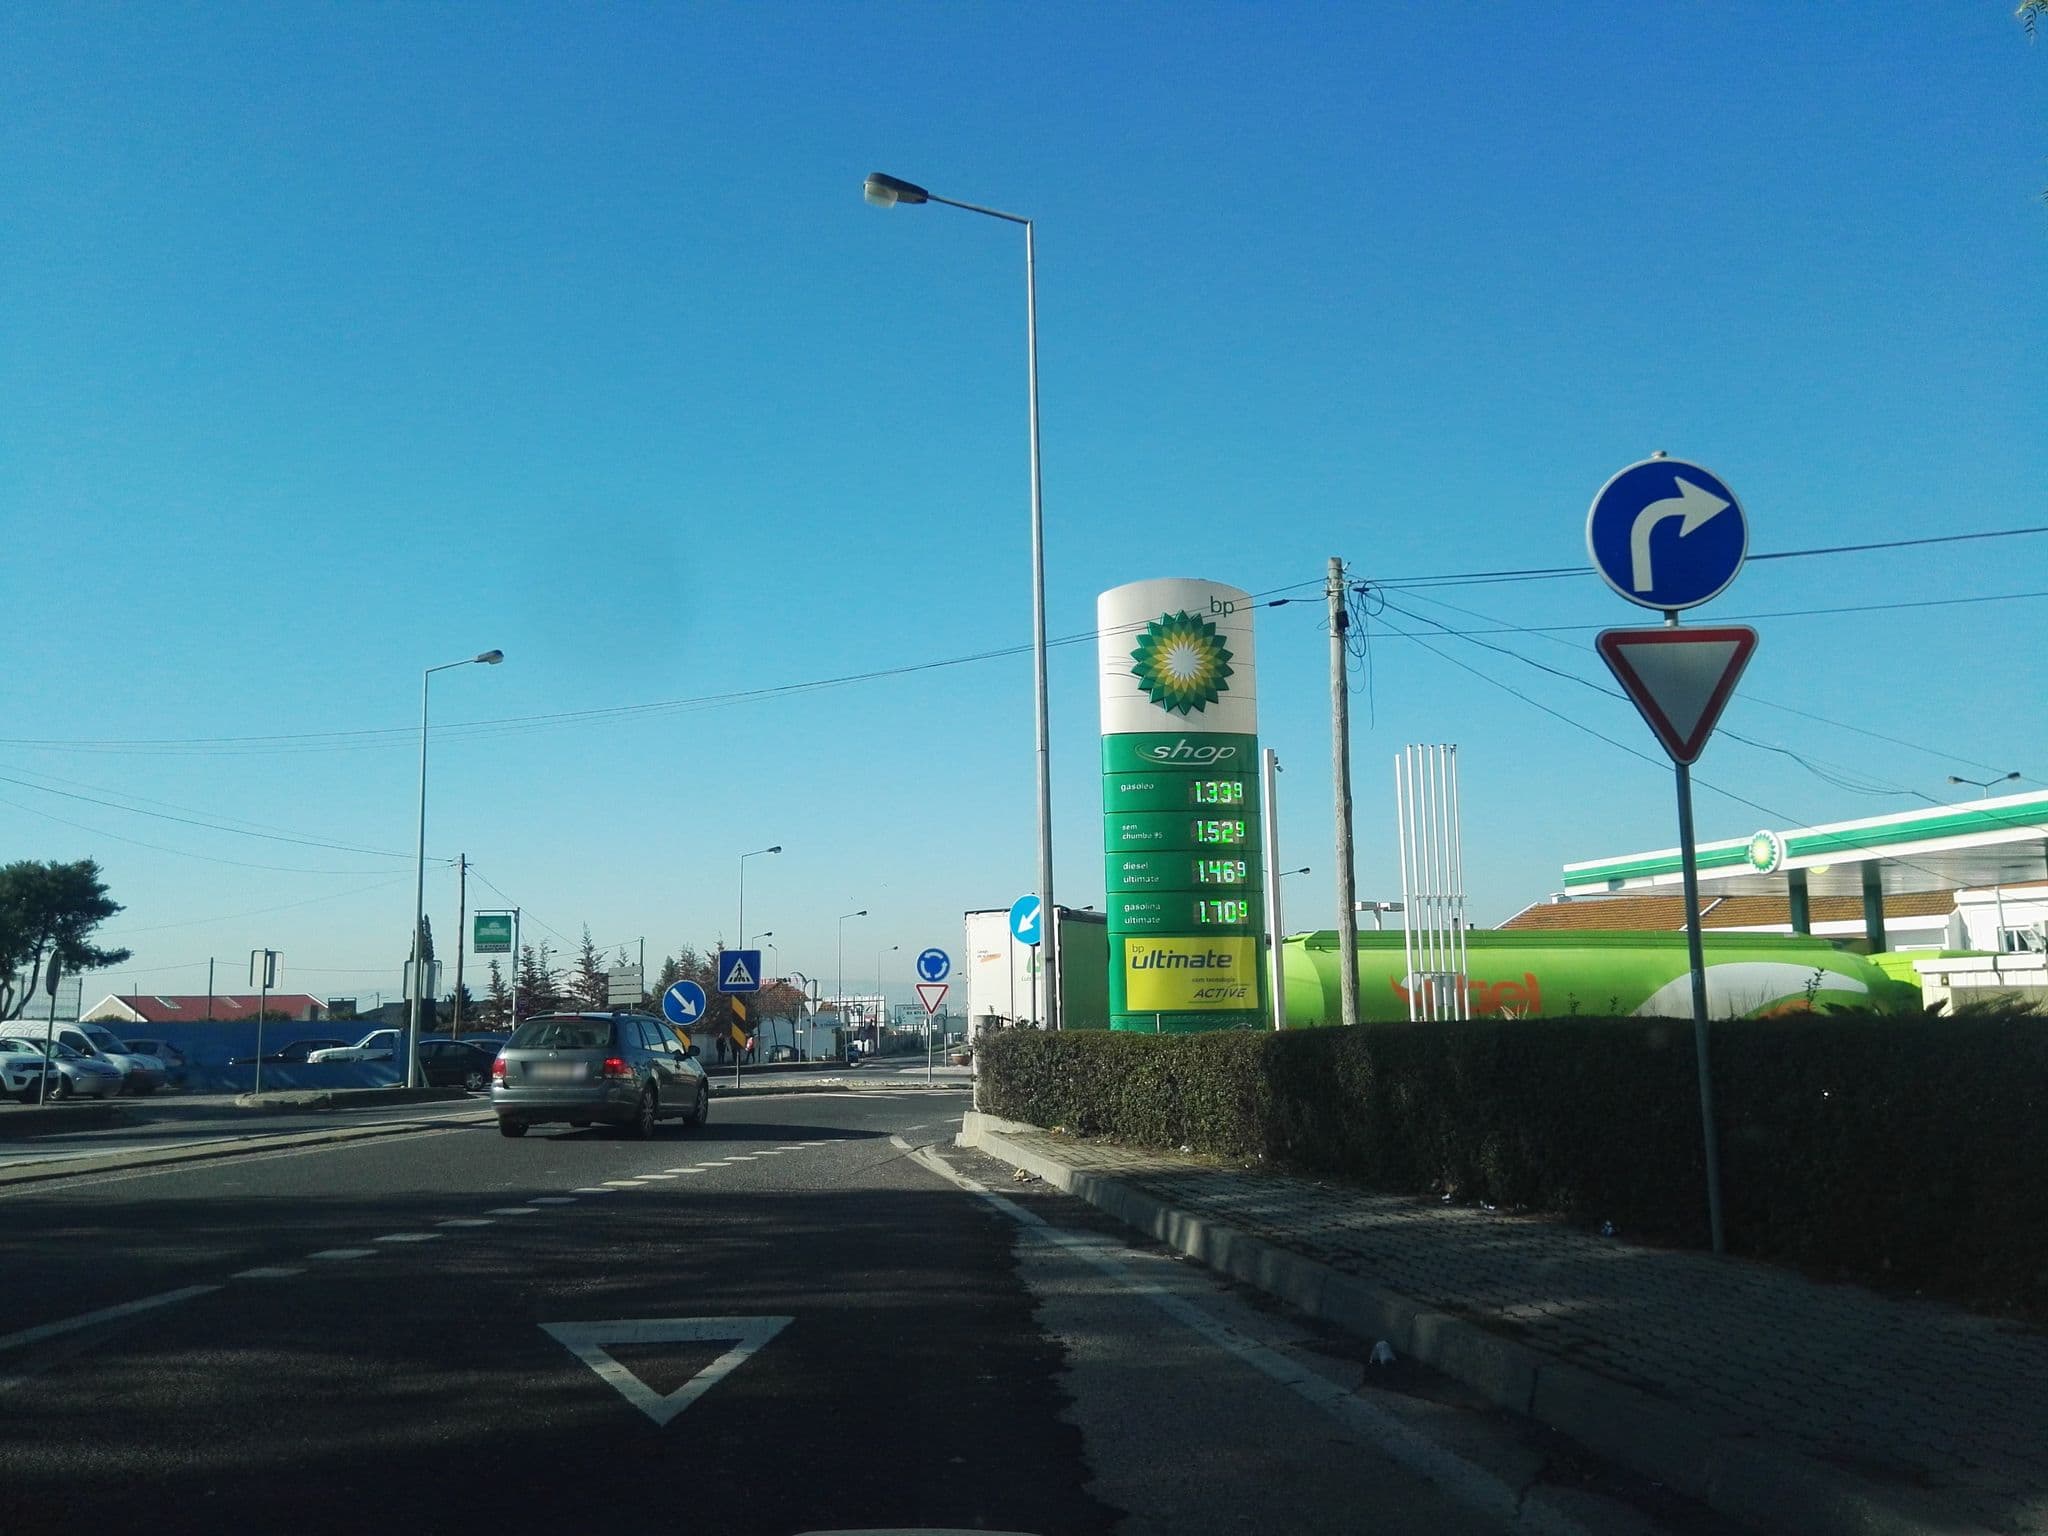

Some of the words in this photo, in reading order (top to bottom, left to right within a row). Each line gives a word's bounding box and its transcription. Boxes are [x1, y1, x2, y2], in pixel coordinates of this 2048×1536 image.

[1210, 596, 1235, 618] bp
[1153, 739, 1236, 765] shop
[1195, 781, 1242, 803] 1.339
[1197, 820, 1244, 843] 1.529
[1123, 861, 1149, 870] diesel
[1198, 860, 1246, 883] 1.469
[1123, 875, 1160, 884] ultimate
[1124, 903, 1161, 912] gasolina
[1200, 900, 1248, 923] 1.709
[1125, 915, 1161, 924] ultimate
[1131, 944, 1145, 954] bp
[1131, 949, 1233, 970] ultimate
[1193, 988, 1247, 999] ACTIVE
